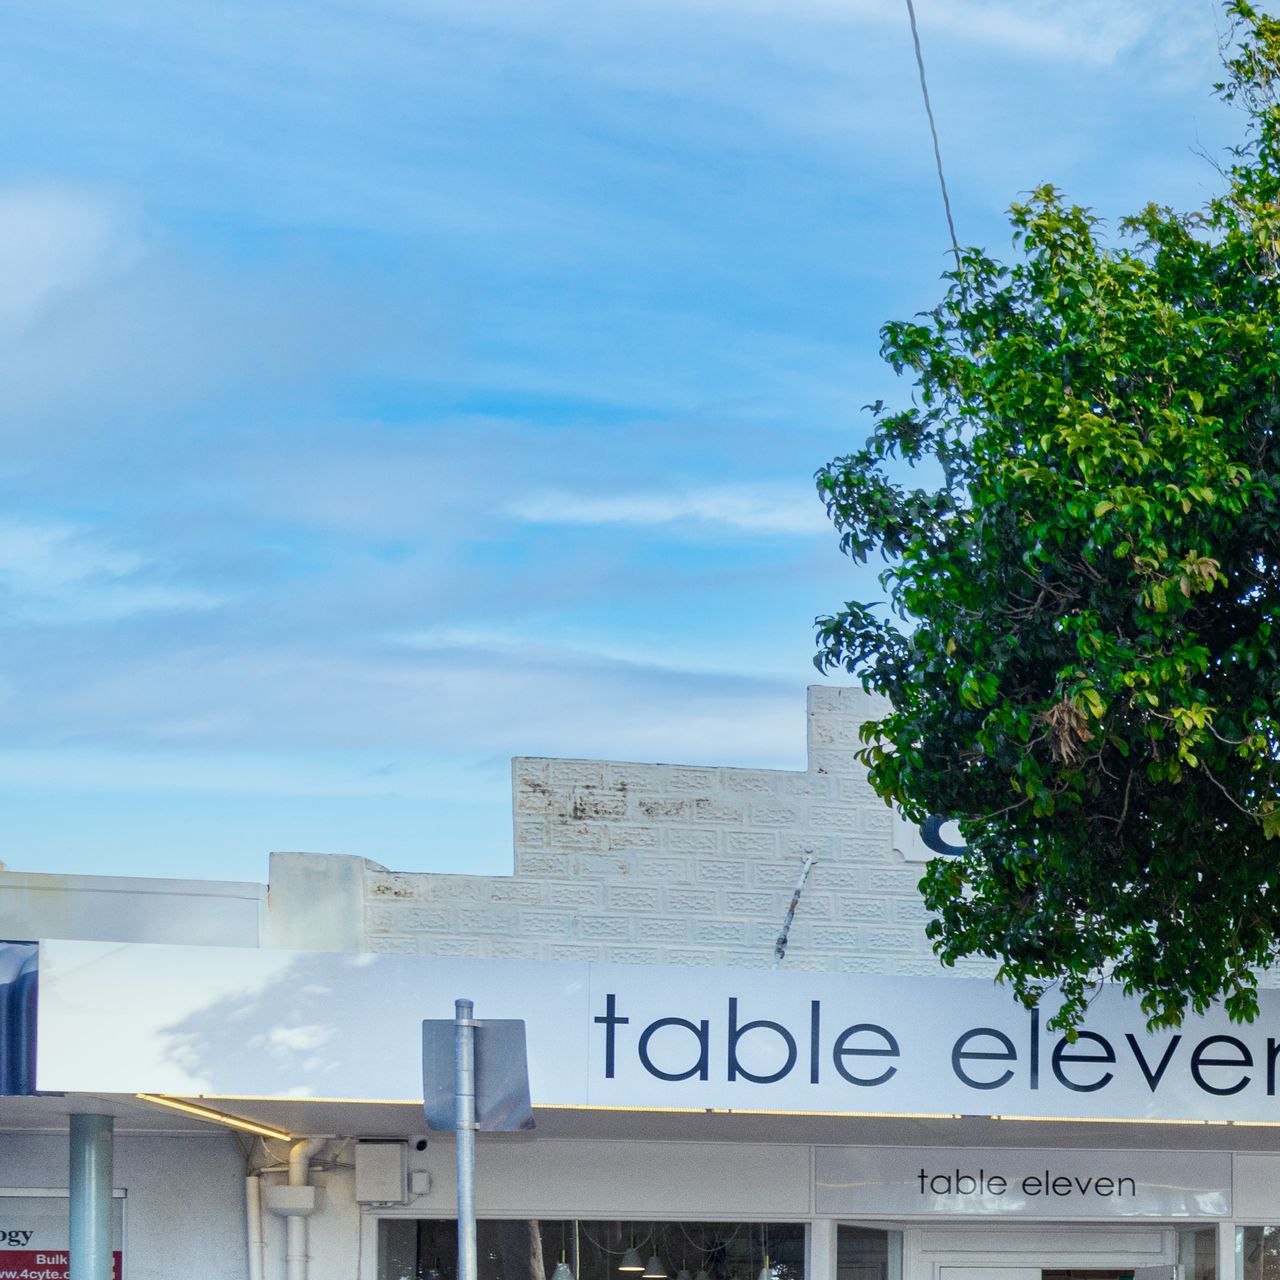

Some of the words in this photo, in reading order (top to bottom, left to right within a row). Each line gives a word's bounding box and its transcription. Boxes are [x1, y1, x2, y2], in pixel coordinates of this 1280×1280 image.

[593, 993, 901, 1087] table
[917, 1167, 1008, 1197] table
[1021, 1169, 1137, 1198] eleven
[36, 1254, 69, 1265] Bulk
